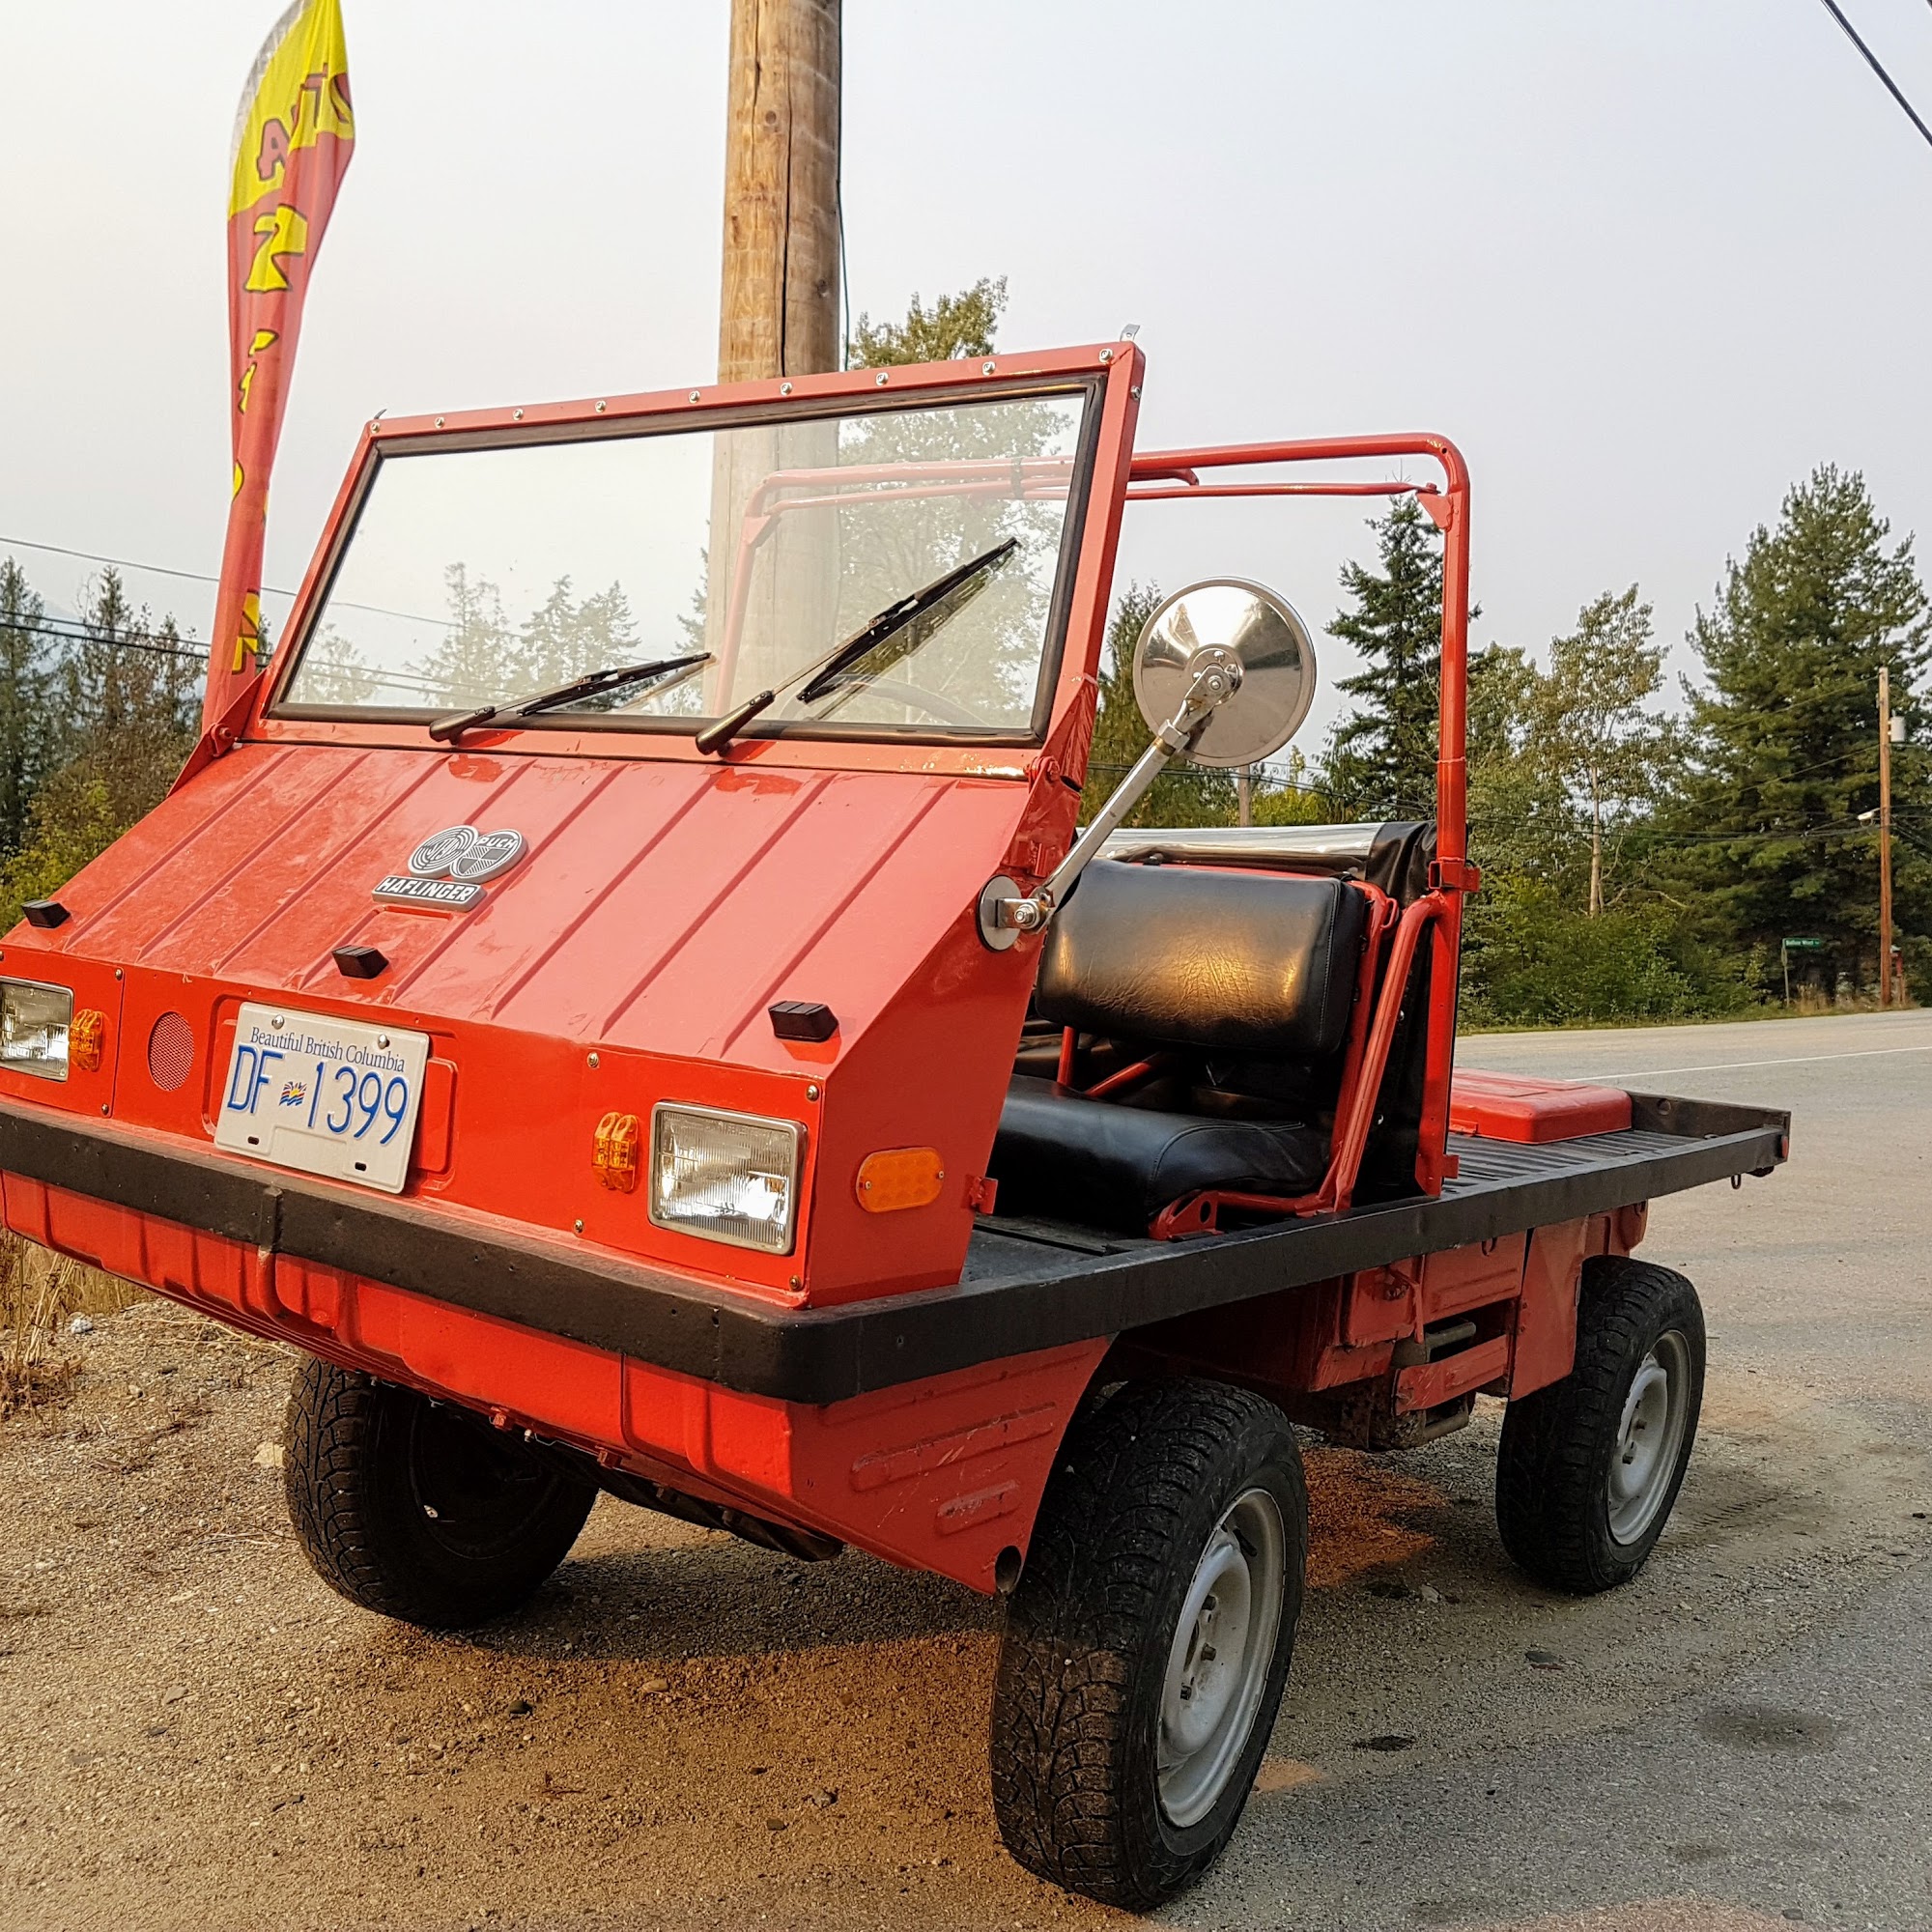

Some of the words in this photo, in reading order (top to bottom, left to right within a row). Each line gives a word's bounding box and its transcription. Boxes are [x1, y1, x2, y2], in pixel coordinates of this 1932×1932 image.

[476, 837, 518, 848] PUCH
[376, 877, 476, 901] HAFLINGER
[250, 1027, 303, 1052] Beautiful
[304, 1037, 343, 1061] British
[346, 1045, 405, 1072] Columbia
[227, 1044, 286, 1114] DF
[307, 1061, 410, 1146] 1399
